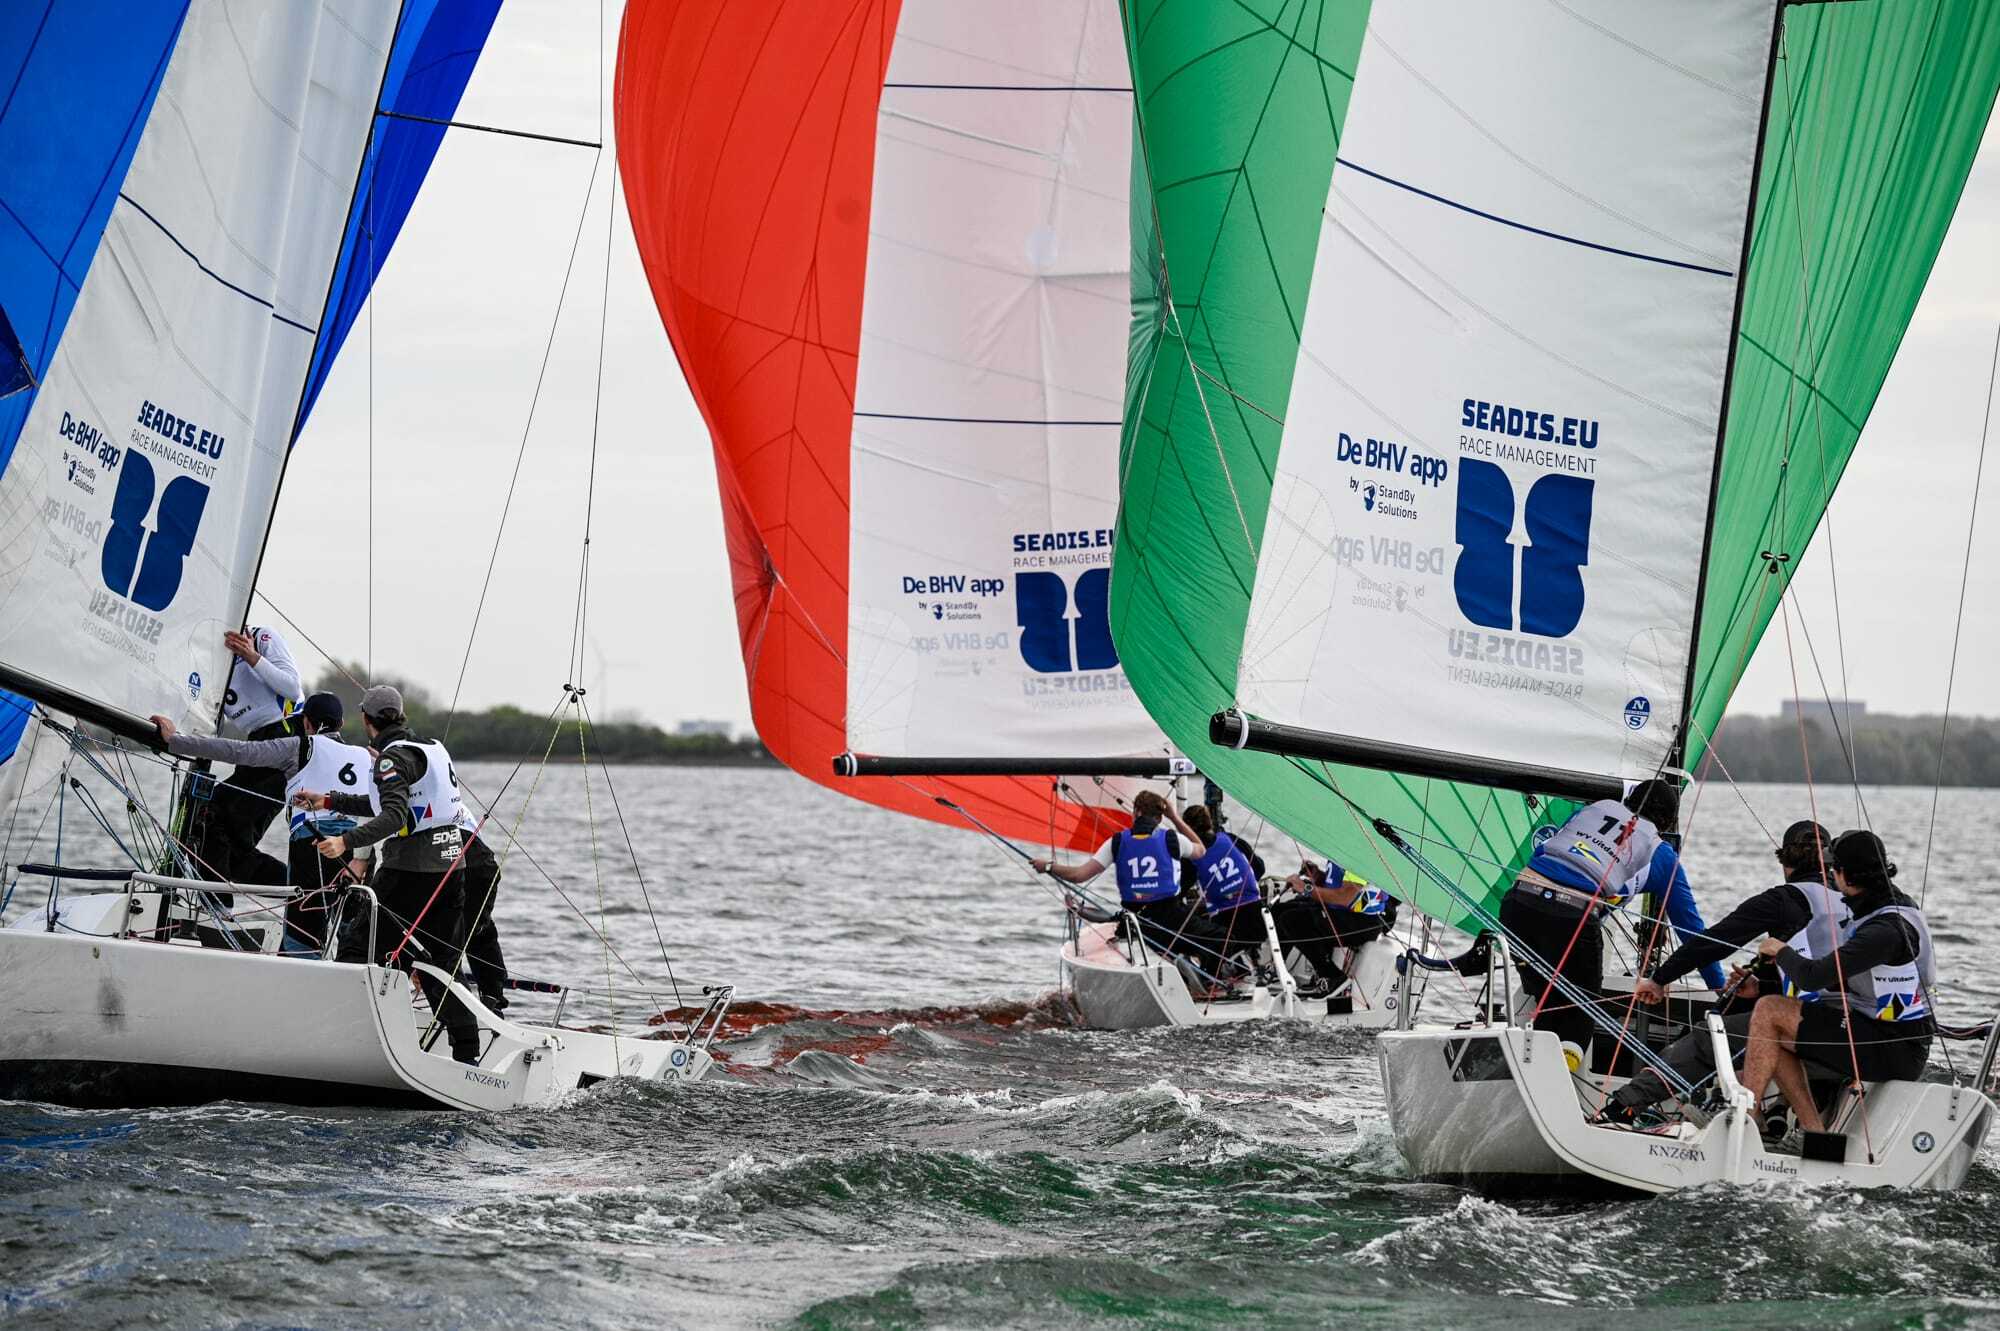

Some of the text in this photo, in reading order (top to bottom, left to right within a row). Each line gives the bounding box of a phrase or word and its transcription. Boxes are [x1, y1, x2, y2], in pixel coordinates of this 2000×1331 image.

[137, 400, 225, 460] SEADIS.EU
[1462, 399, 1599, 449] SEADIS.EU
[59, 411, 121, 473] De BHV app
[130, 428, 217, 481] RACE MANAGEMENT
[1337, 432, 1447, 487] De BHV app
[1459, 435, 1597, 474] RACE MANAGEMENT
[1350, 476, 1359, 493] by
[1378, 484, 1415, 505] StandBy
[1378, 501, 1417, 520] Solutions
[1013, 556, 1046, 568] RACE
[903, 575, 1004, 597] De BHV app
[1631, 700, 1646, 711] N
[1629, 716, 1641, 727] S
[338, 762, 357, 786] 6
[448, 762, 458, 788] 6
[1128, 856, 1159, 878] 12
[1208, 857, 1240, 882] 12
[1752, 1159, 1798, 1175] Muiden
